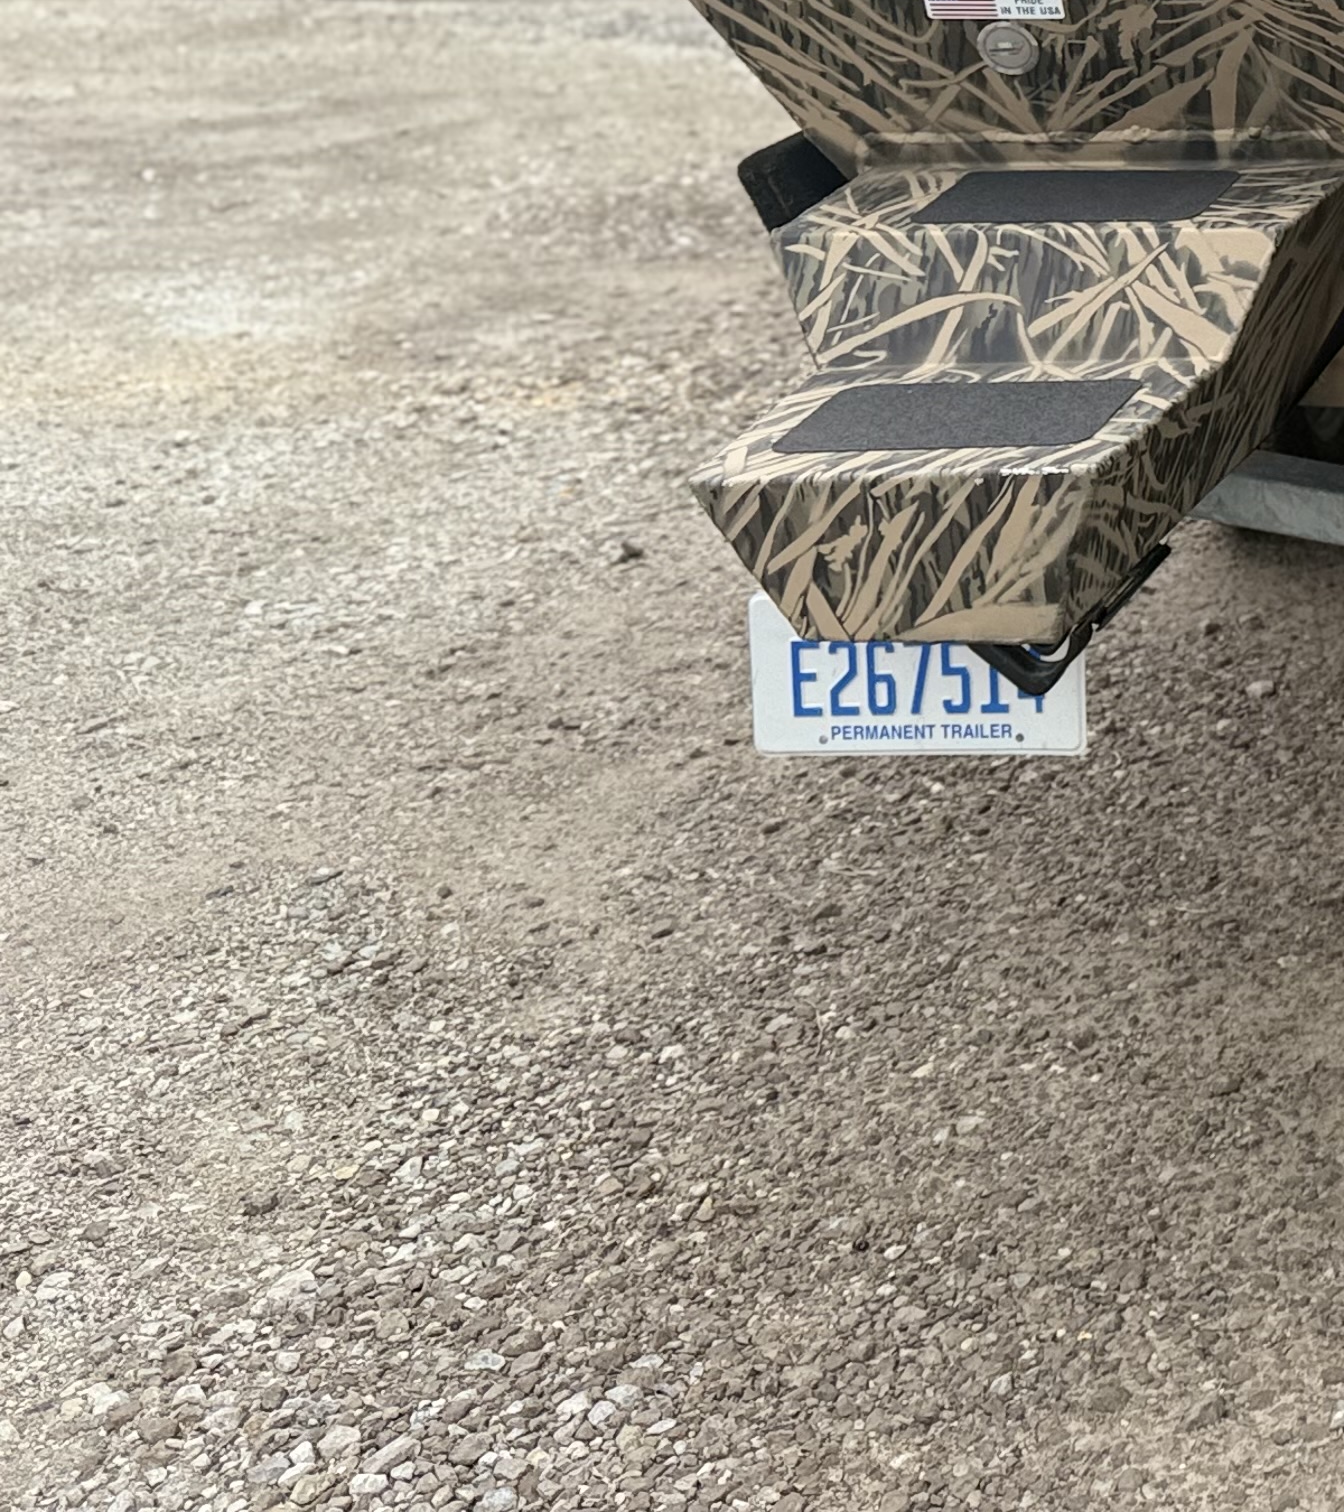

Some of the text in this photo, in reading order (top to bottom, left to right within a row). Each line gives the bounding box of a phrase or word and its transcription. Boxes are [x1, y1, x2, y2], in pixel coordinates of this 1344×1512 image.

[1000, 6, 1061, 15] IN THE USA
[831, 724, 1013, 740] PERMANENT TRAILER
